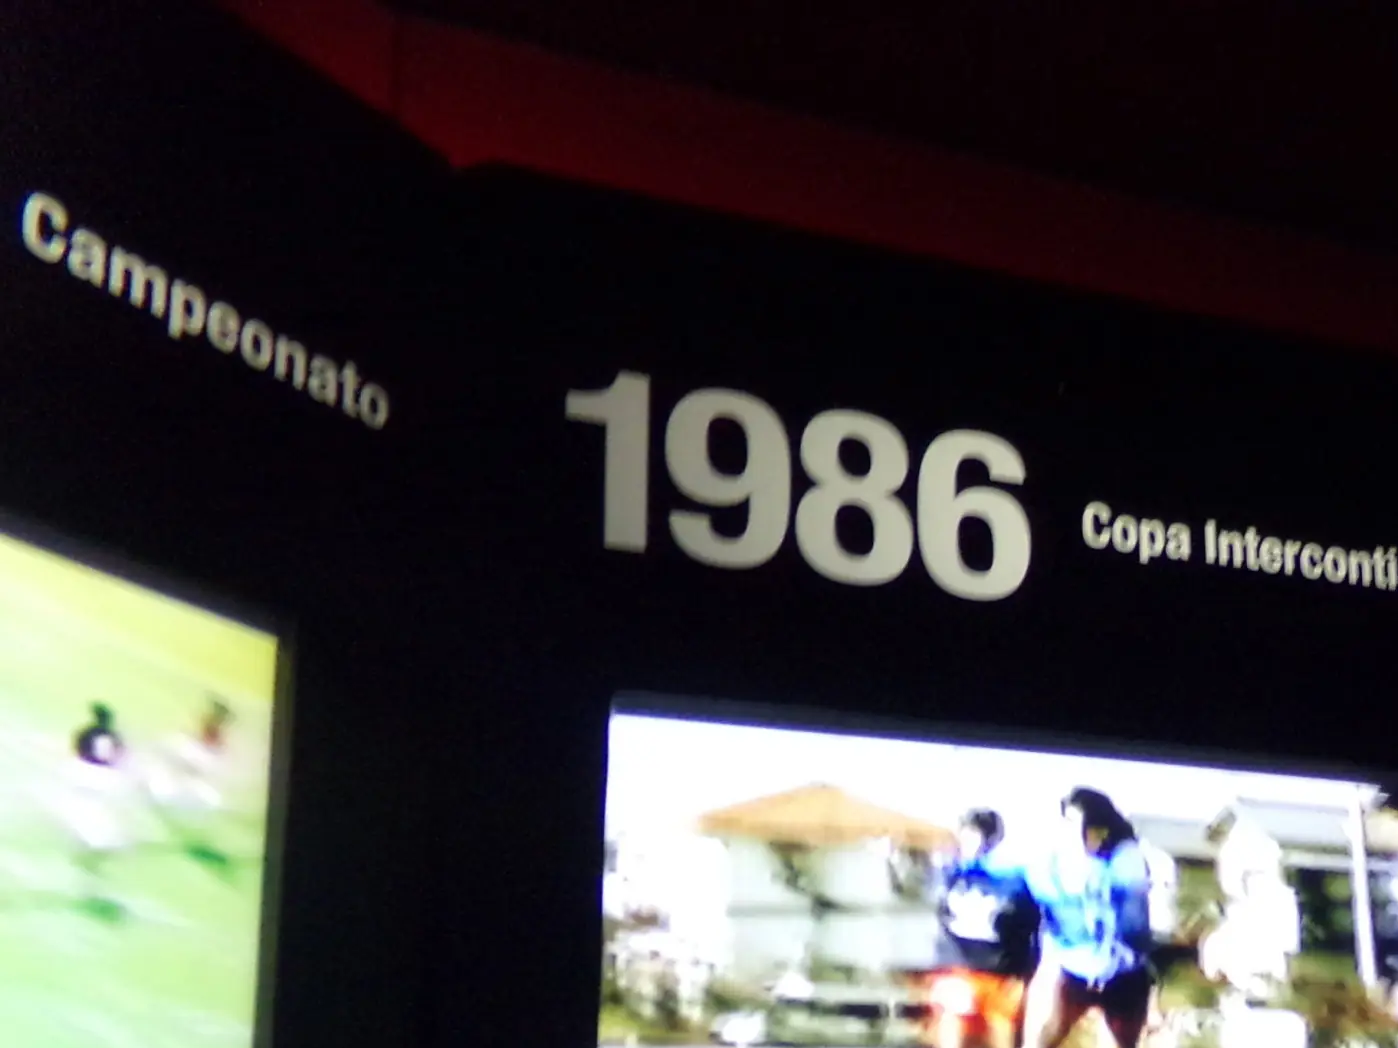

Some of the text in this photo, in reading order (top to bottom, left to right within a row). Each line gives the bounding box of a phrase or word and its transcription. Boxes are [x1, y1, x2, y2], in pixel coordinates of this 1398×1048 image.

[19, 190, 389, 430] Campeonato
[565, 371, 1033, 603] 1986
[1081, 500, 1192, 564] Copa
